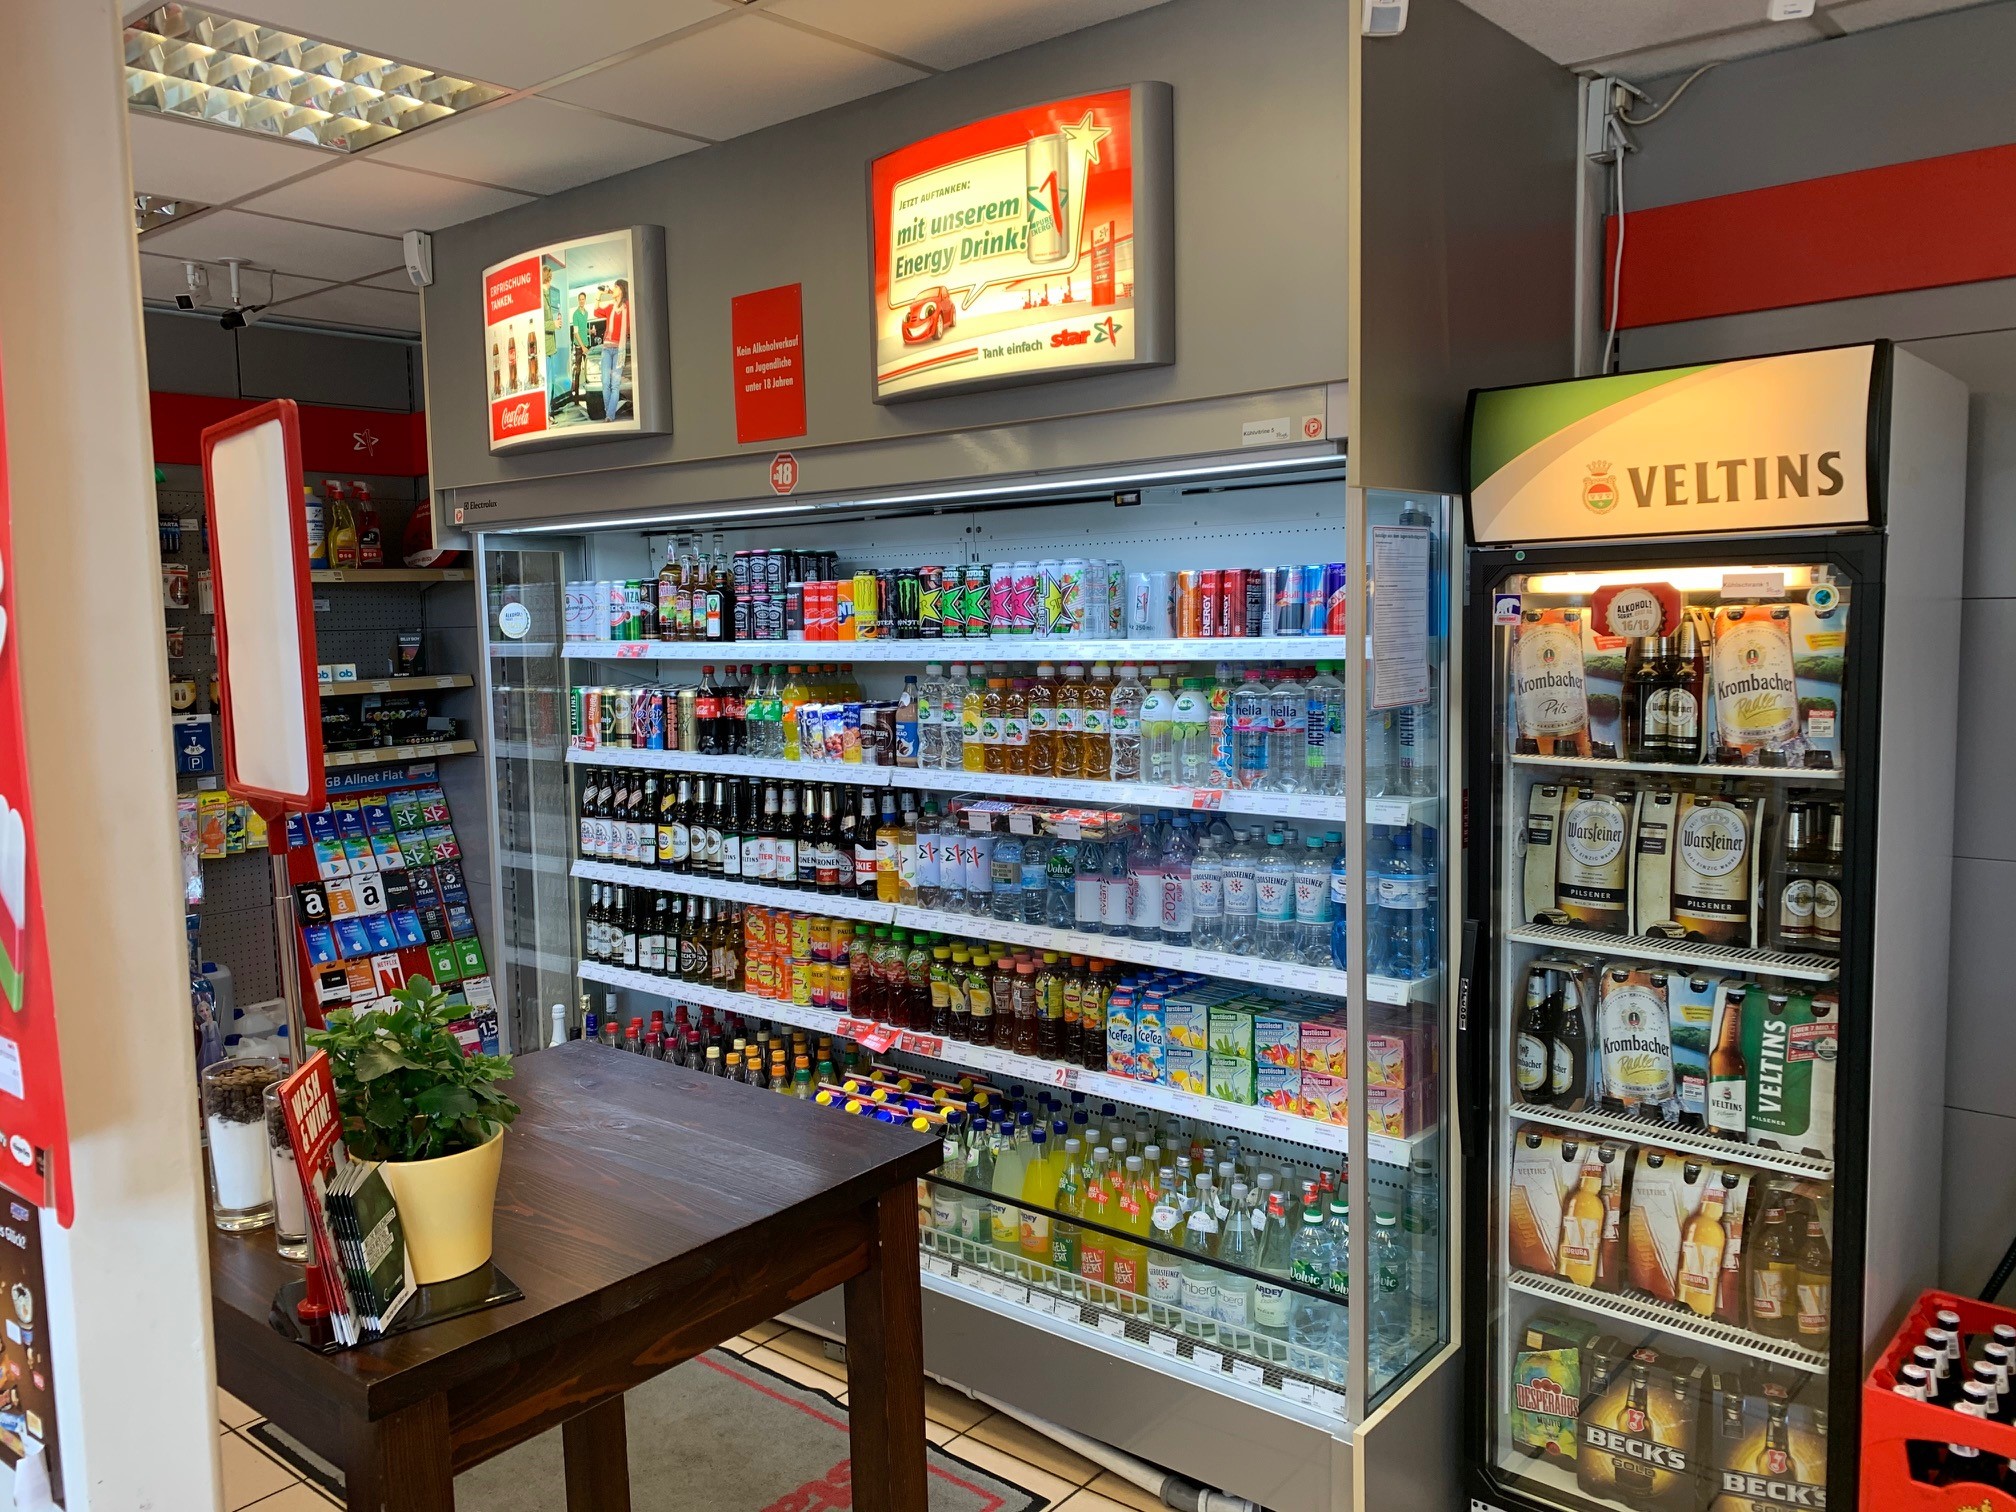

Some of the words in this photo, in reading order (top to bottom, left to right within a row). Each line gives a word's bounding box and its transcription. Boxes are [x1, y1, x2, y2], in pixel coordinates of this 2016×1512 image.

[898, 196, 919, 211] JETZT
[920, 180, 971, 203] AUFTANKEN:
[897, 216, 926, 247] mit
[930, 197, 1020, 235] unserem
[895, 245, 957, 280] Energy
[960, 224, 1028, 261] Drink!
[490, 272, 532, 297] ERFRISCHUNG
[490, 295, 514, 311] TANKEN.
[736, 343, 751, 357] Kein
[752, 334, 799, 355] Alkoholverkauf
[1050, 328, 1091, 348] star
[982, 345, 1005, 360] Tank
[1006, 339, 1043, 357] einfach
[745, 363, 754, 373] an
[755, 357, 792, 375] Jugendliche
[745, 381, 762, 393] unter
[763, 378, 772, 390] 18
[772, 375, 794, 389] Jahren
[776, 462, 792, 485] 18
[1627, 450, 1845, 509] VELTINS
[470, 500, 498, 510] Electrolux
[1202, 594, 1212, 636] ENERGY
[1222, 594, 1231, 636] ENERGY
[1617, 600, 1652, 613] ALKOHOL?
[1621, 619, 1650, 632] 16/18
[1518, 670, 1584, 696] Krombacher
[1718, 673, 1793, 701] Krombacher
[1236, 704, 1262, 716] hella
[1270, 705, 1296, 717] hella
[1538, 698, 1569, 719] Pils
[1734, 693, 1783, 718] Radler
[1308, 710, 1326, 747] ACTIVE
[325, 775, 341, 788] GB
[344, 772, 380, 785] Allnet
[382, 769, 404, 781] Flat
[1568, 822, 1622, 842] Warsteiner
[1684, 830, 1743, 852] Warsteiner
[1579, 852, 1598, 861] EINZIG
[1600, 846, 1616, 860] WAHRE
[1696, 861, 1718, 871] EINZIG
[1720, 856, 1737, 870] WAHRE
[1048, 863, 1073, 874] Volvic
[362, 885, 380, 906] a
[416, 888, 434, 896] STEAM
[444, 882, 462, 890] STEAM
[1570, 888, 1611, 899] PILSENER
[306, 893, 324, 915] a
[1164, 882, 1176, 921] 2020
[1687, 900, 1732, 911] PILSENER
[377, 960, 398, 968] NETFLIX
[1604, 1034, 1670, 1057] Krombacher
[1618, 1054, 1660, 1076] Radler
[1758, 1020, 1786, 1112] VELTINS
[1056, 1069, 1063, 1083] 2
[291, 1069, 321, 1118] WASH
[1711, 1099, 1742, 1112] VELTINS
[304, 1094, 332, 1143] WIN!
[1751, 1115, 1786, 1126] PILSENER
[300, 1123, 311, 1154] &
[1518, 1168, 1547, 1176] VELTINS
[1637, 1188, 1667, 1197] VELTINS
[1564, 1247, 1588, 1257] CURUBA
[1114, 1262, 1132, 1273] GEL
[1290, 1269, 1320, 1286] Volvic
[1114, 1273, 1132, 1284] BERT
[1683, 1272, 1707, 1285] CURUBA
[1255, 1284, 1283, 1298] ARDEY
[1516, 1384, 1580, 1418] DESPERADOS
[1586, 1426, 1686, 1470] BECK'S
[1612, 1458, 1656, 1478] GOLD
[1723, 1472, 1826, 1507] BECK'S
